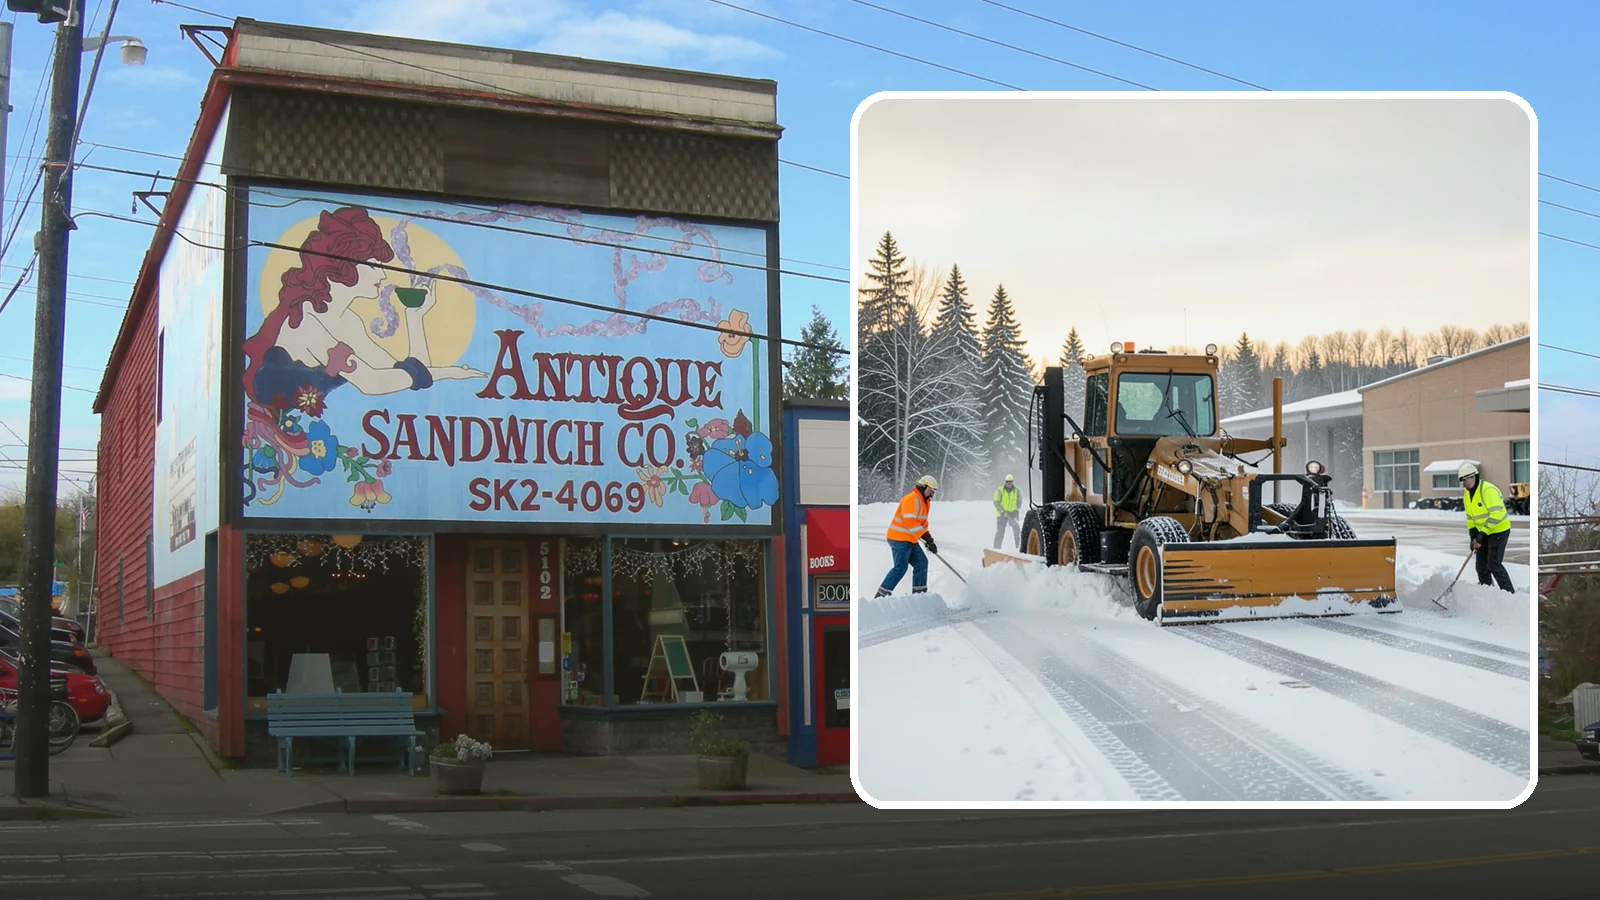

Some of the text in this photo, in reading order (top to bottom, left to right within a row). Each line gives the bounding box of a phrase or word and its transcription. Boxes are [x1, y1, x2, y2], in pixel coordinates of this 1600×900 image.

[476, 329, 723, 420] ANTIQUE
[361, 408, 685, 469] SANDWICH CO.
[468, 476, 646, 514] SK2-4069
[540, 541, 551, 600] 5102
[809, 555, 835, 569] BOOKS
